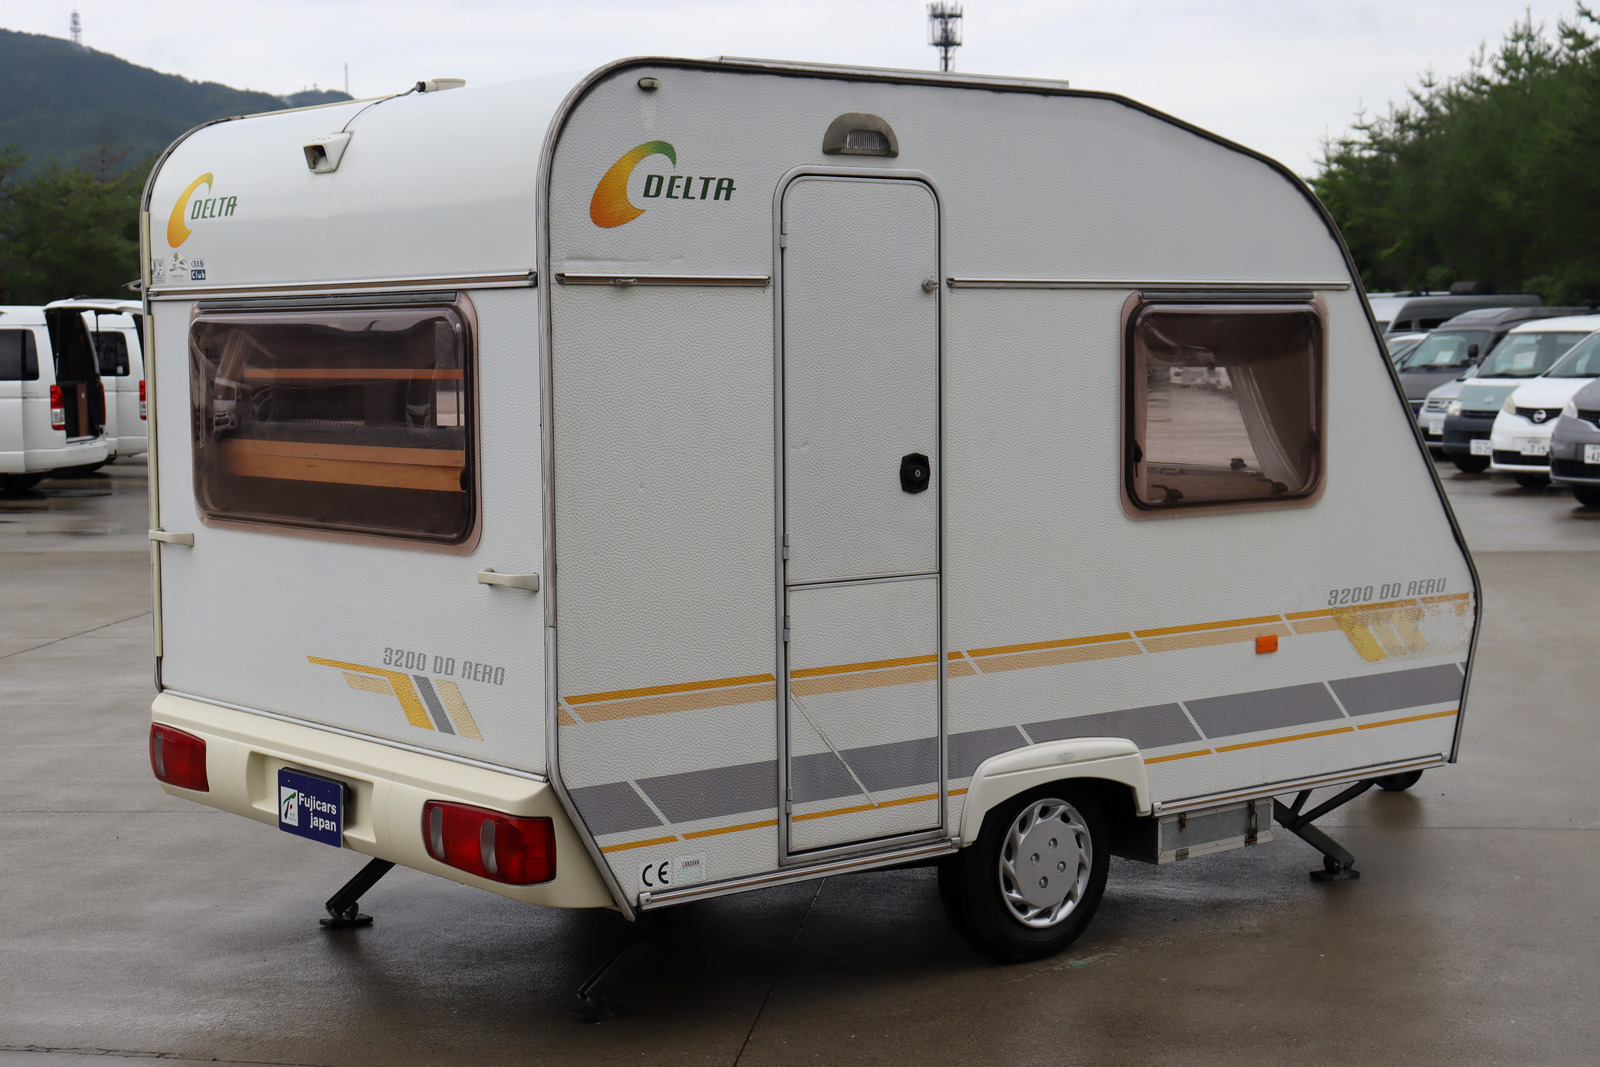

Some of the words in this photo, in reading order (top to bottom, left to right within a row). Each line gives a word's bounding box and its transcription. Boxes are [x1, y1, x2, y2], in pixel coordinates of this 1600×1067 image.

[643, 174, 737, 201] DELTA
[190, 195, 238, 220] DELTA
[1327, 585, 1374, 606] 3200
[1406, 577, 1447, 596] AERO
[382, 647, 427, 671] 3200
[461, 660, 506, 686] AERO
[298, 792, 337, 815] Fujicars
[309, 812, 337, 832] japan
[641, 860, 669, 887] CE
